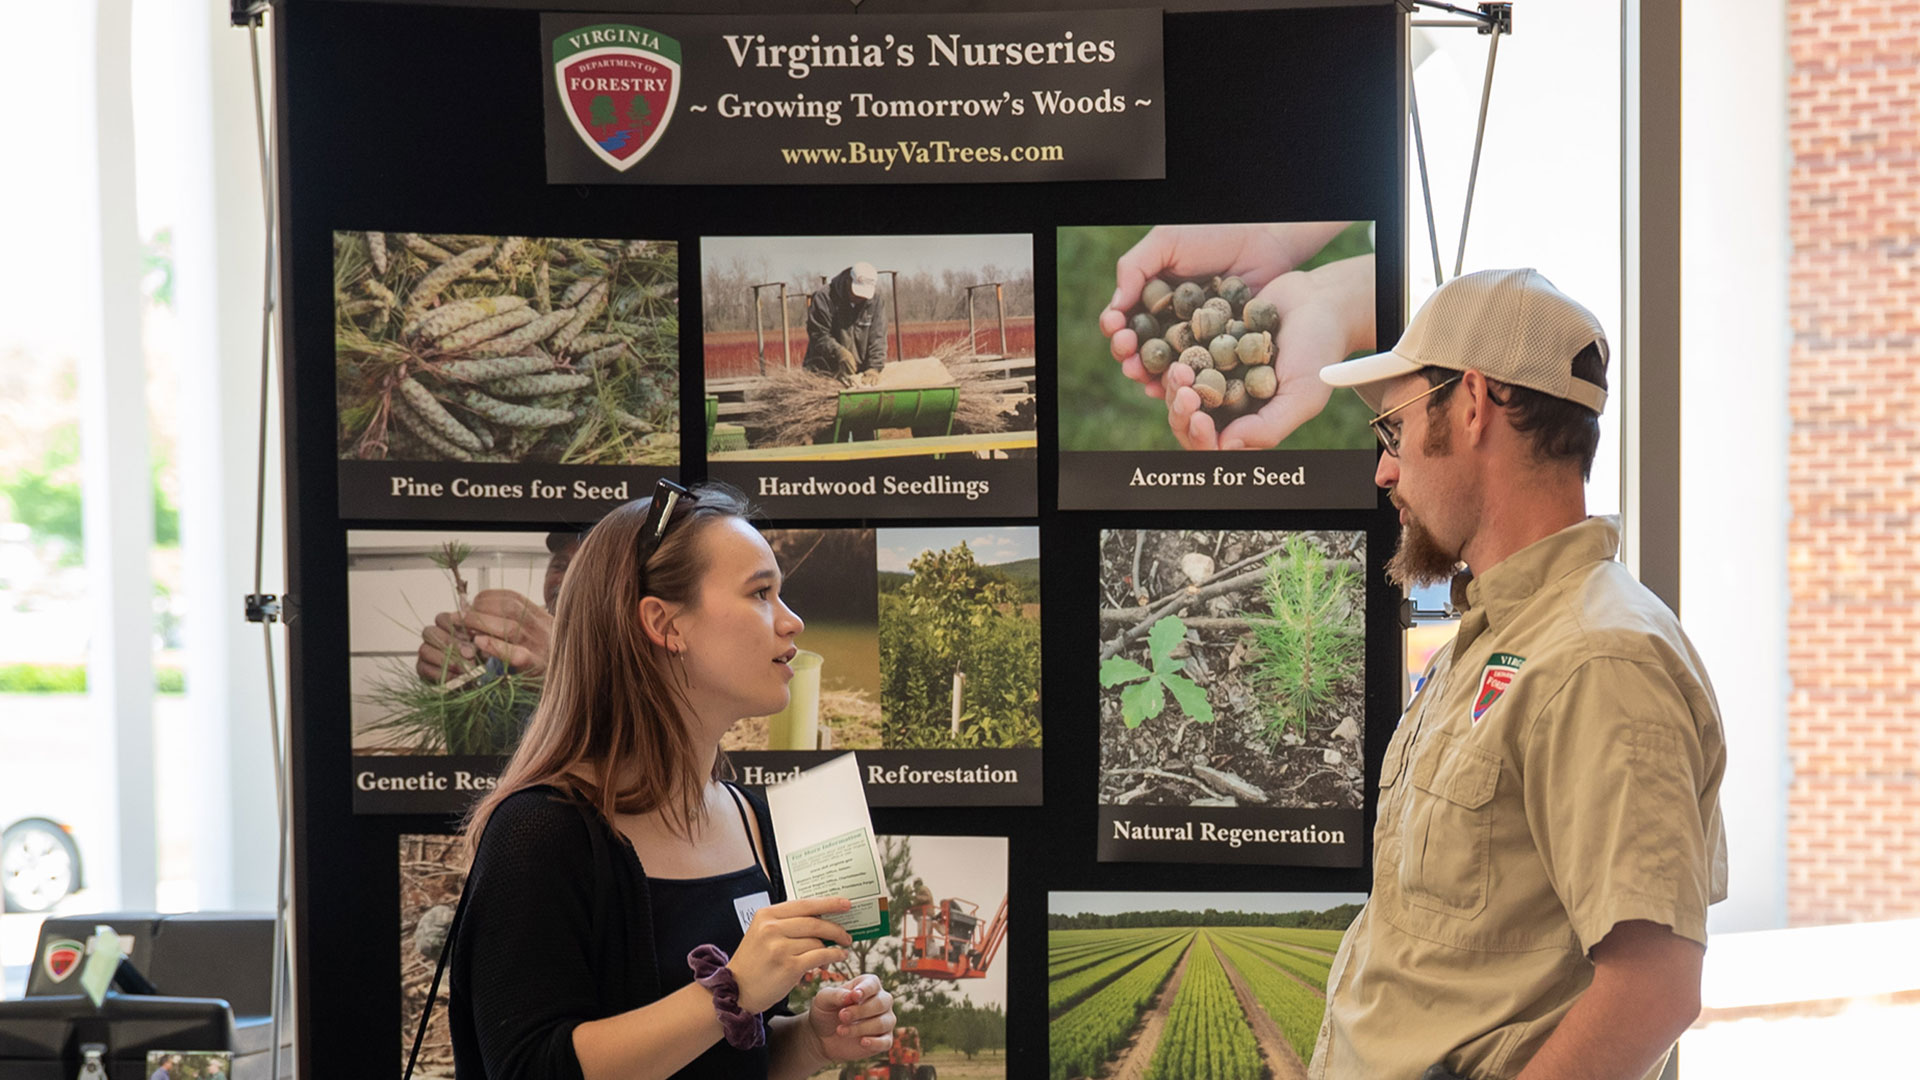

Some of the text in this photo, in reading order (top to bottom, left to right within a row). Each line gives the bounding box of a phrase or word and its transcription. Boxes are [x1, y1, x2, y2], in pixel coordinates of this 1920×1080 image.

[569, 28, 660, 50] VIRGINIA
[578, 59, 659, 74] DEPARTMENT OF
[722, 31, 1116, 79] Virginia’s Nurseries
[570, 77, 668, 92] FORESTRY
[717, 93, 842, 126] Growing
[850, 91, 1025, 118] Tomorrow’s
[1032, 88, 1126, 115] Woods
[781, 141, 1065, 171] www.BuyVaTrees.com
[758, 475, 989, 500] Hardwood Seedlings
[1129, 466, 1306, 486] Acorns for Seed
[390, 476, 629, 500] Pine Cones for Seed
[356, 771, 498, 791] Genetic Res
[743, 764, 1019, 786] Hard Reforestation
[1112, 820, 1345, 848] Natural Regeneration
